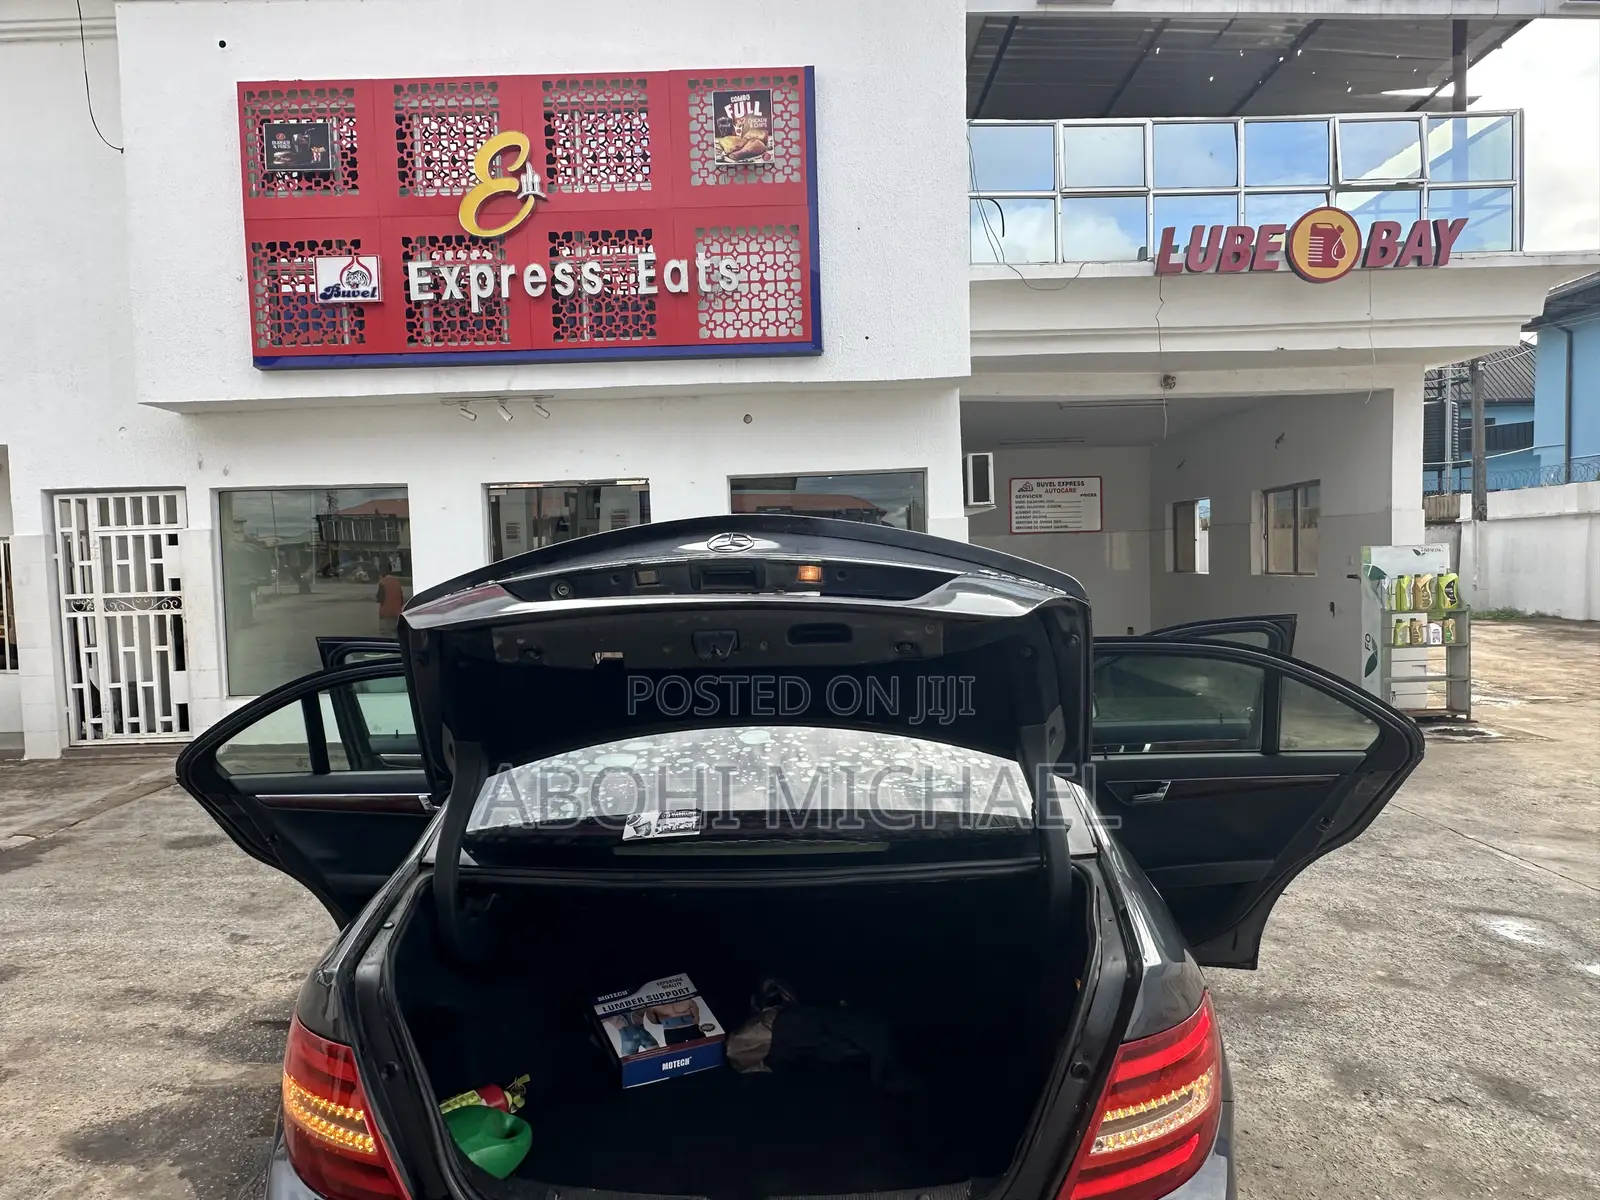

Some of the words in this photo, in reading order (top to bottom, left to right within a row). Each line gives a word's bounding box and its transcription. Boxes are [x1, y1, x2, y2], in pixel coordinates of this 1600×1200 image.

[730, 94, 750, 102] COMBO
[724, 101, 762, 119] FULL
[1154, 223, 1287, 275] LUBE
[1361, 217, 1469, 269] BAY
[408, 260, 603, 313] Express
[638, 251, 742, 296] Eats
[319, 283, 378, 300] Buvel
[597, 990, 628, 1002] MOTECH
[602, 997, 644, 1012] LUMBER
[646, 987, 690, 1002] SUPPORT
[662, 1058, 690, 1070] MOTECH
